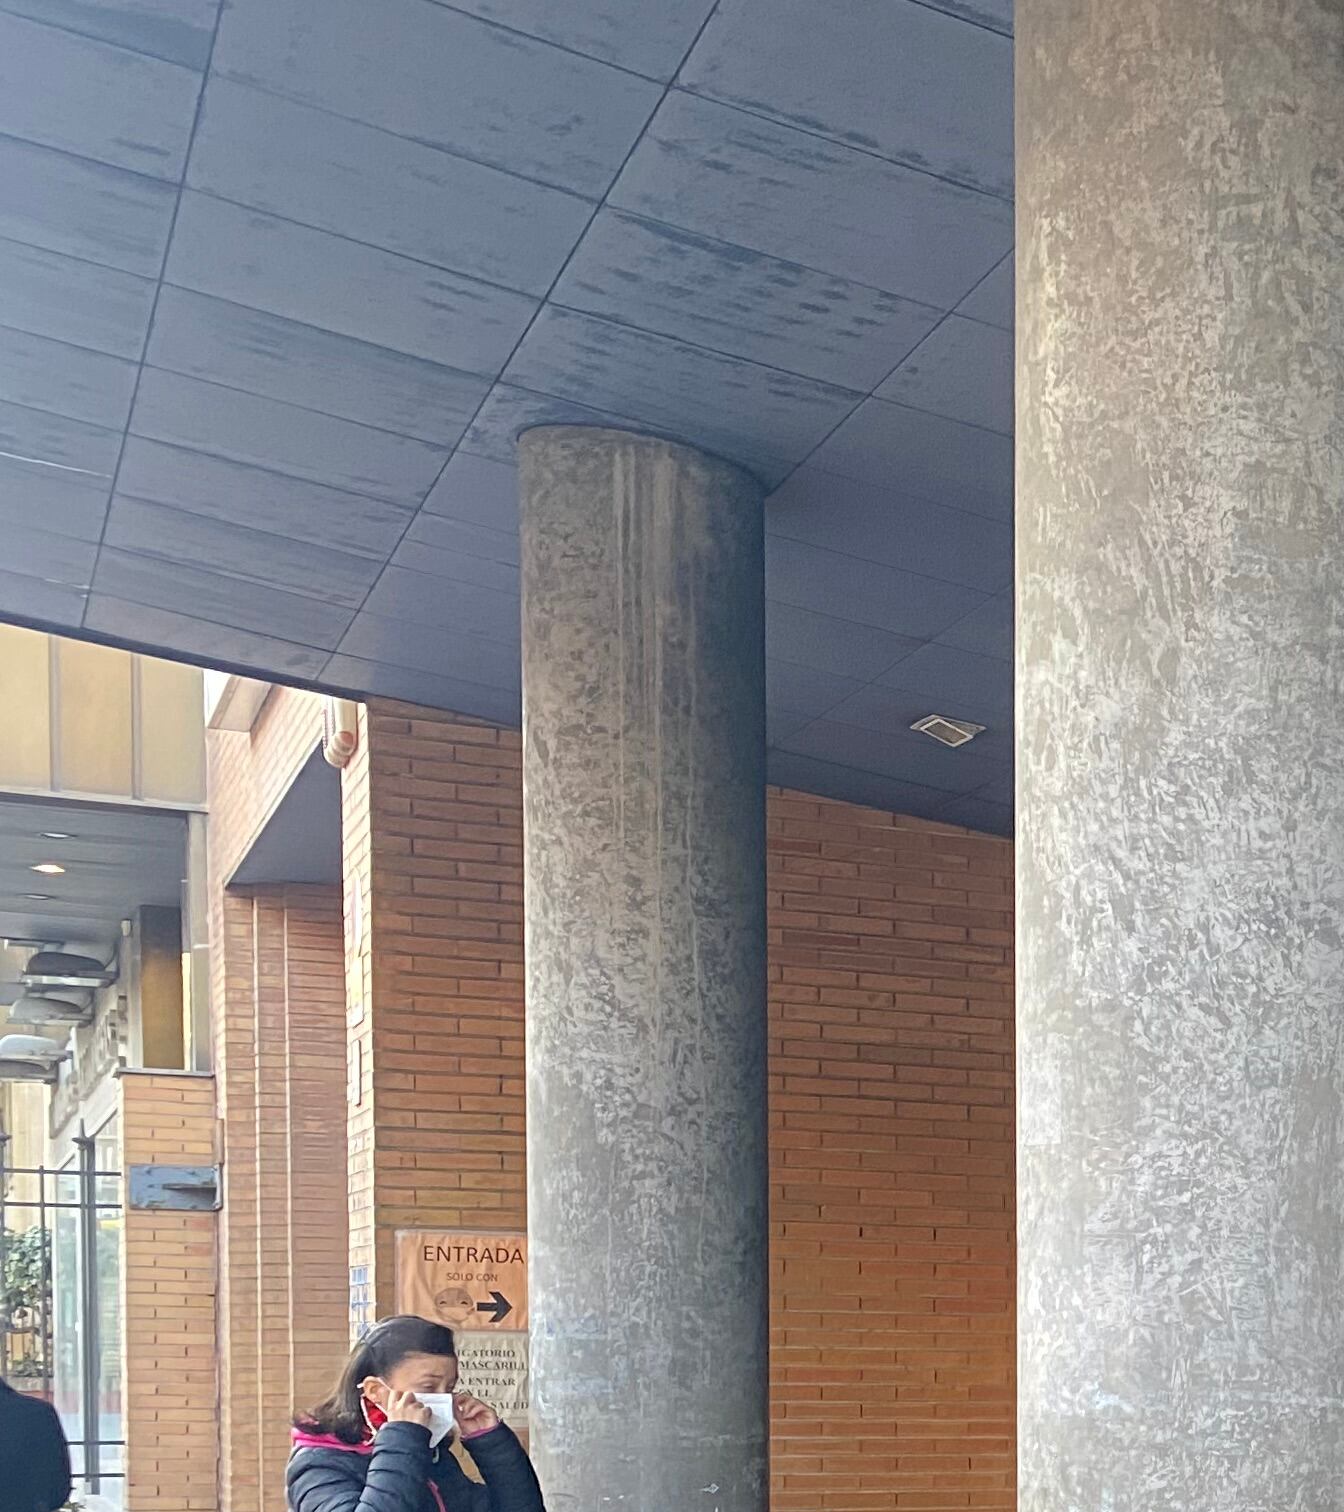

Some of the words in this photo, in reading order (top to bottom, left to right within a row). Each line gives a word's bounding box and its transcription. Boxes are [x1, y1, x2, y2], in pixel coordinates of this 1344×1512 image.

[423, 1245, 525, 1264] ENTRADA
[446, 1272, 474, 1282] SOLO
[476, 1272, 498, 1282] CON
[468, 1377, 516, 1386] ENTRAR
